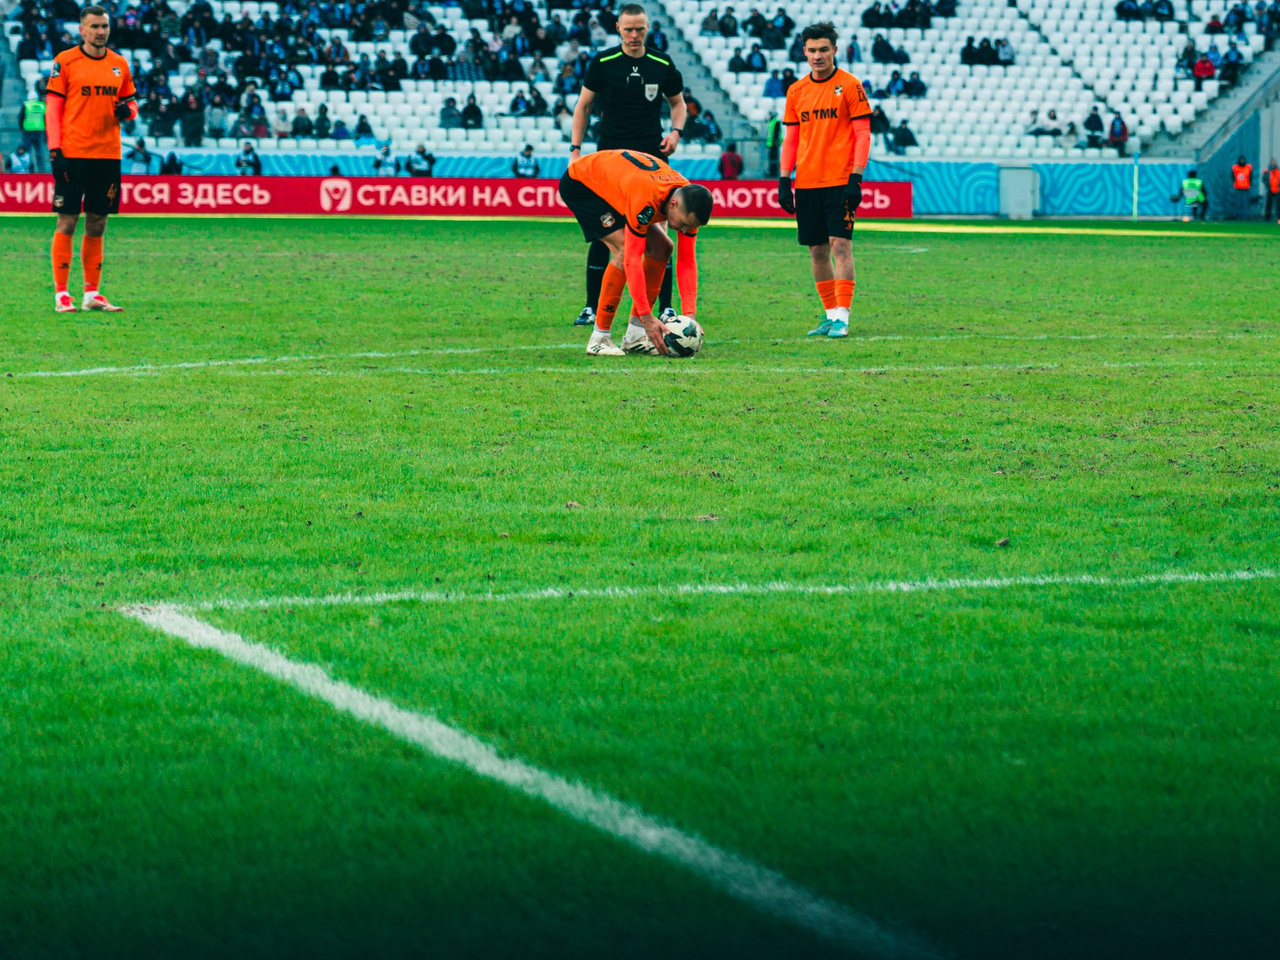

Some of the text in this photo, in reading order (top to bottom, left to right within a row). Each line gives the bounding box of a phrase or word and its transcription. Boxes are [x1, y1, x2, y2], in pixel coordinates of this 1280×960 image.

[177, 183, 271, 208] ЗДЕСЬ
[357, 184, 467, 206] СТАВКИ
[473, 186, 511, 206] НА
